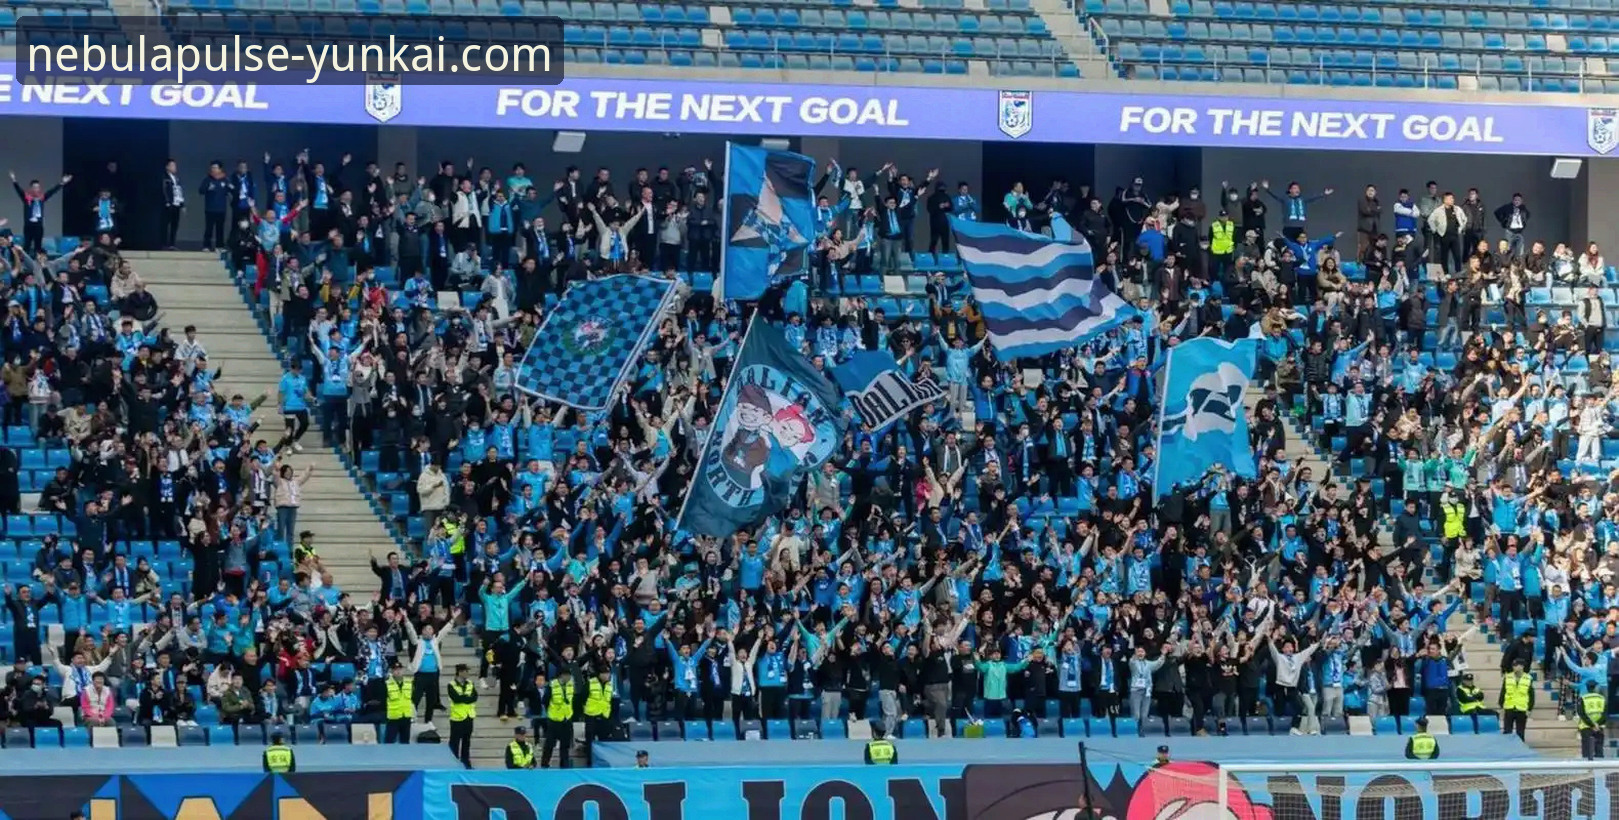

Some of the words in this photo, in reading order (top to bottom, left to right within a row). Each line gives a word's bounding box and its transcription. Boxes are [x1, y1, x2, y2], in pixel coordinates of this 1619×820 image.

[22, 75, 142, 105] NEXT
[150, 79, 269, 109] GOAL
[496, 88, 580, 118] FOR
[590, 91, 671, 120] THE
[680, 94, 792, 123] NEXT
[800, 97, 909, 127] GOAL
[1119, 106, 1197, 134] FOR
[1207, 108, 1282, 136] THE
[1290, 111, 1394, 140] NEXT
[1402, 114, 1504, 143] GOAL
[706, 430, 756, 507] NORTH
